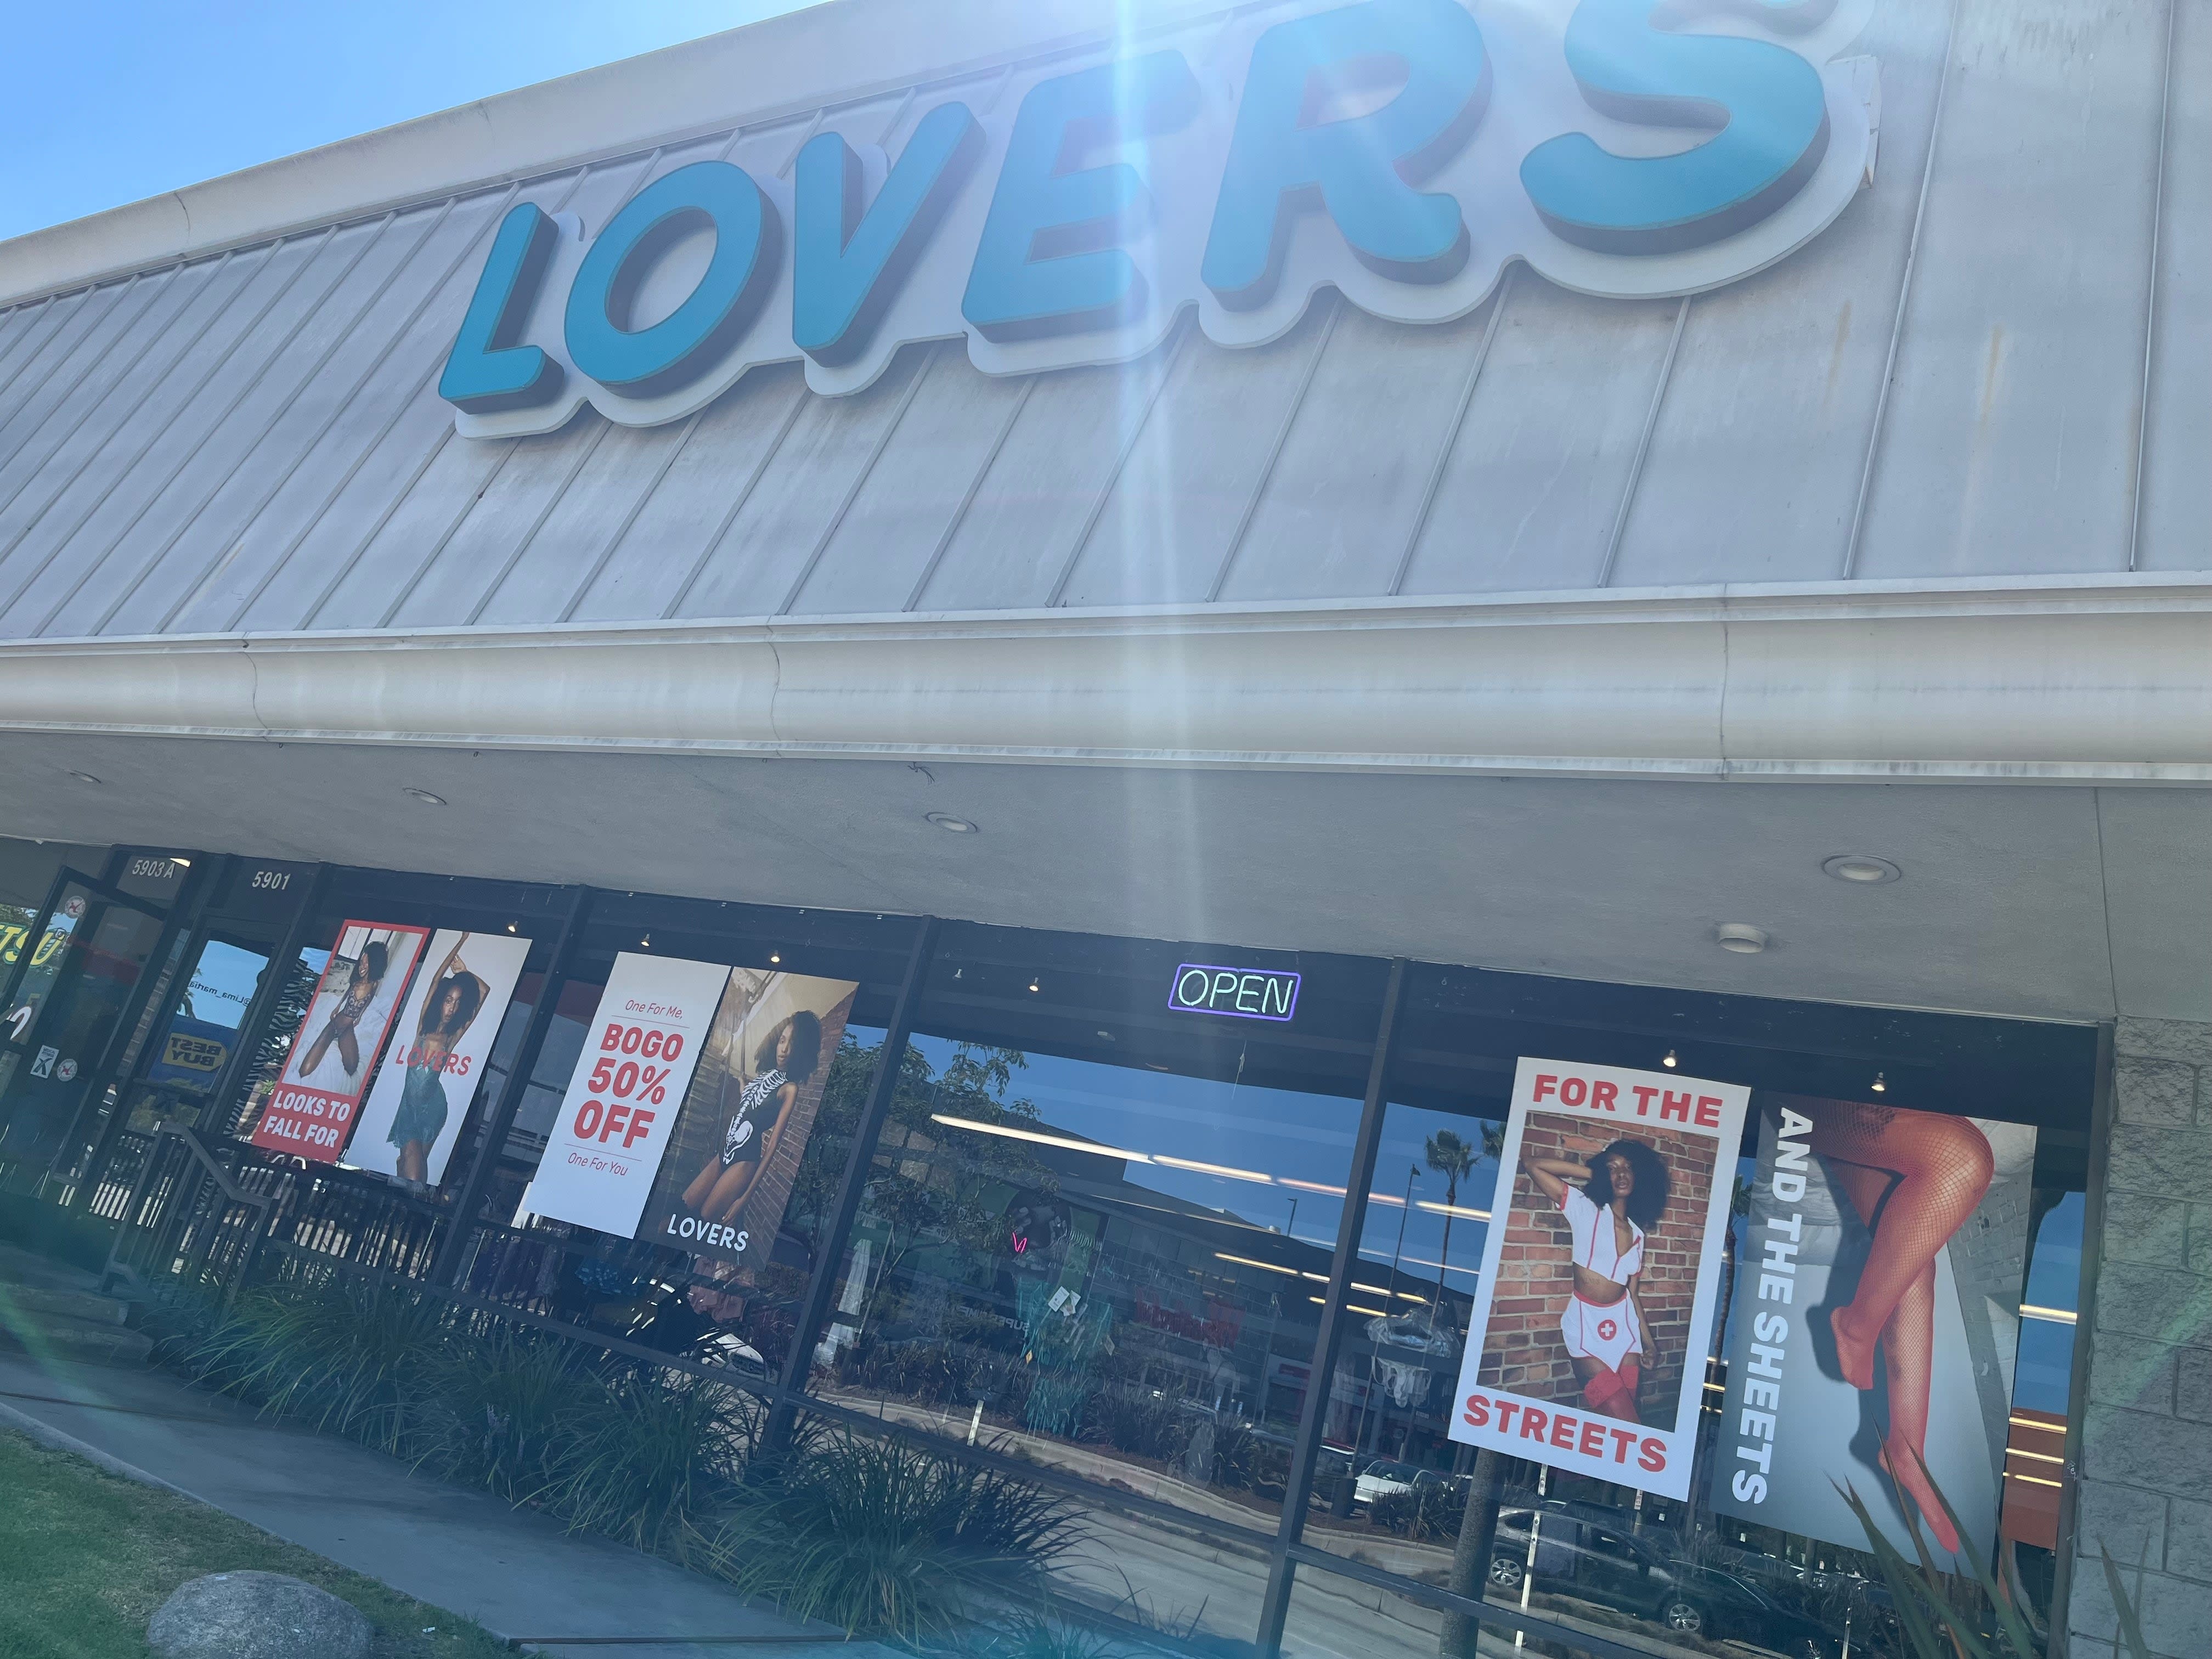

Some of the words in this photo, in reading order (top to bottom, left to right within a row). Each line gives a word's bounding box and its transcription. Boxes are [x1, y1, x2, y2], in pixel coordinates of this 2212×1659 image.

[439, 0, 1827, 409] LOVERS
[132, 860, 165, 877] 5903
[163, 862, 176, 878] A
[252, 871, 291, 890] 5901
[625, 999, 645, 1014] One
[647, 1003, 664, 1016] For
[665, 1005, 684, 1019] Me,
[1178, 969, 1294, 1014] OPEN
[396, 1045, 472, 1076] LOVERS
[600, 1024, 684, 1062] BOGO
[588, 1057, 672, 1105] 50%
[1533, 1074, 1620, 1111] FOR
[1632, 1086, 1723, 1128] THE
[273, 1091, 325, 1119] LOOKS
[329, 1101, 351, 1122] TO
[573, 1100, 656, 1149] OFF
[263, 1115, 302, 1141] FALL
[304, 1124, 339, 1148] FOR
[567, 1152, 588, 1167] One
[590, 1158, 607, 1171] For
[608, 1161, 628, 1176] You
[1771, 1106, 1813, 1203] AND
[667, 1214, 749, 1252] LOVERS
[1759, 1213, 1802, 1306] THE
[1732, 1311, 1787, 1505] SHEETS
[1463, 1394, 1668, 1473] STREETS
